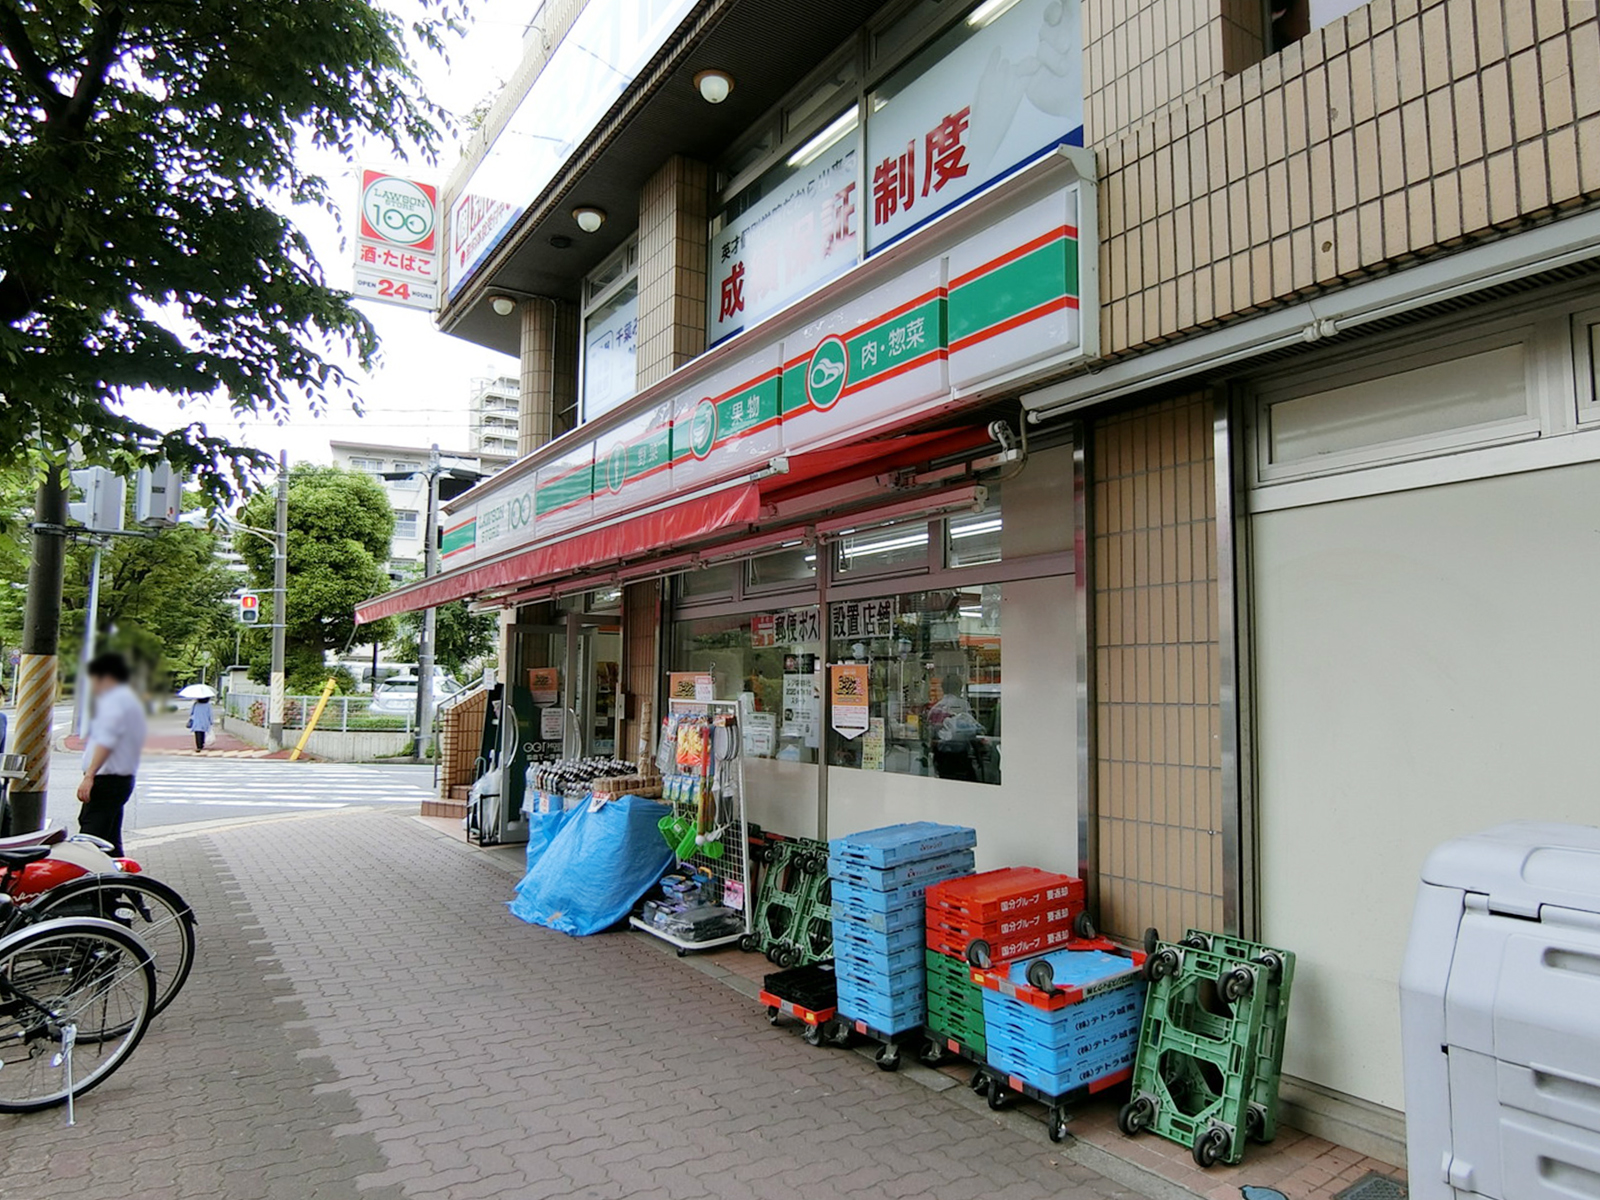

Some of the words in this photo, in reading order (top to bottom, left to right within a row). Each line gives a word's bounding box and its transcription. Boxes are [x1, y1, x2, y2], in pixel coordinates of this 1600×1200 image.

[873, 105, 971, 227] 制度
[373, 188, 427, 208] LAWSON
[384, 199, 415, 211] STORE
[372, 203, 427, 235] 100
[360, 244, 431, 275] 酒・たばこ
[357, 279, 377, 288] OPEN
[378, 279, 410, 300] 24
[411, 291, 433, 300] HOURS
[861, 316, 925, 370] 肉・惣菜
[730, 394, 760, 426] 果物
[507, 492, 531, 533] 100
[832, 600, 891, 638] 設置店舗
[1000, 893, 1040, 912] 国分グループ
[1001, 915, 1040, 934] 国分グループ
[1001, 937, 1041, 957] 国分グループ
